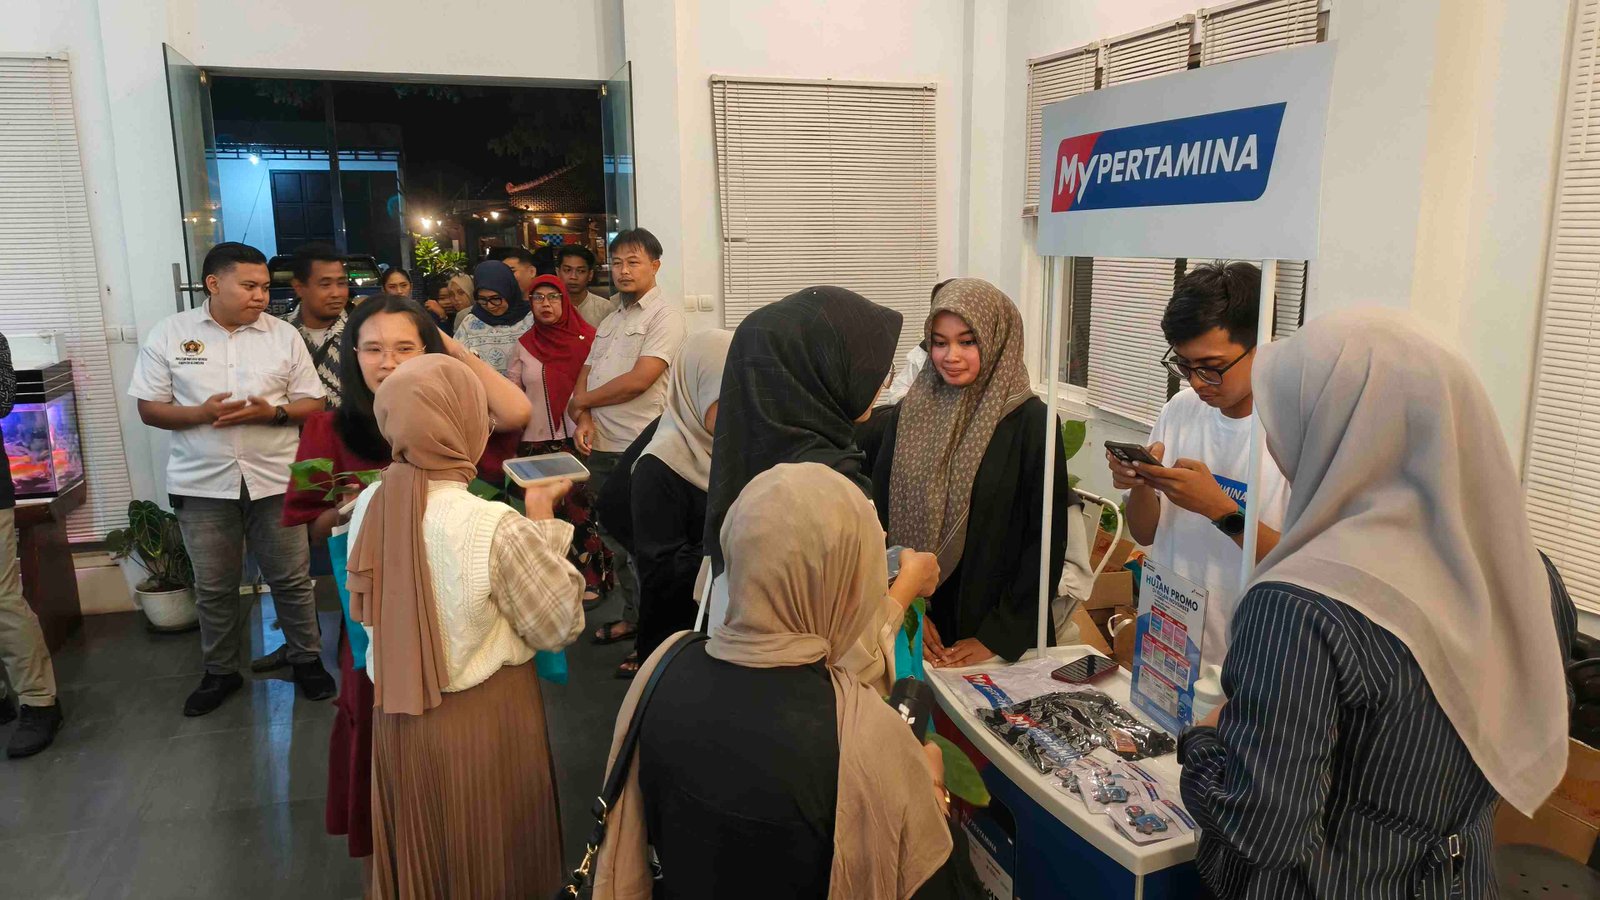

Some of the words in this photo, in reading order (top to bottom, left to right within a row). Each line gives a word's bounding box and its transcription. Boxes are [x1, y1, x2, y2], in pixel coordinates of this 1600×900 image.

[1057, 134, 1258, 205] MyPERTAMINA
[1217, 482, 1248, 502] MINA
[1146, 574, 1170, 595] HUJAN
[1171, 589, 1198, 611] PROMO
